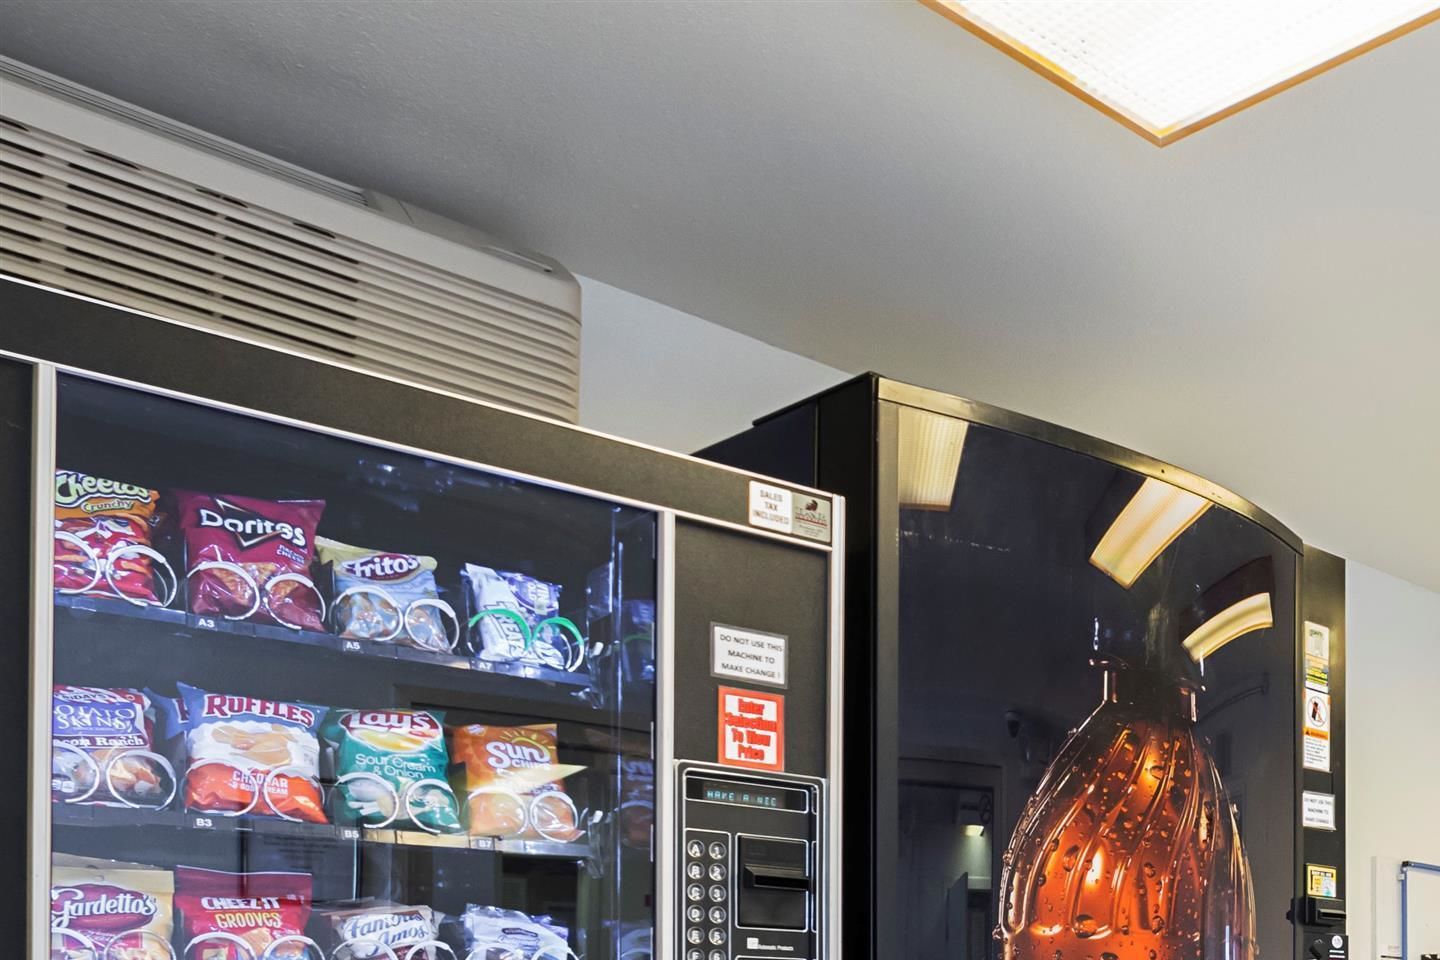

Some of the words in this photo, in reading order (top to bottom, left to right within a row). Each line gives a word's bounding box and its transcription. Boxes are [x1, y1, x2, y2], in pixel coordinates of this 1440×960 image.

[759, 488, 783, 503] SALES
[83, 498, 133, 513] Crunchy
[763, 501, 778, 513] TAX
[201, 509, 308, 547] Doritos
[343, 555, 421, 579] Fritos
[198, 618, 215, 628] A3
[346, 641, 361, 651] A5
[720, 633, 732, 643] DO
[733, 635, 749, 646] NOT
[751, 638, 765, 648] USE
[767, 641, 784, 652] THIS
[727, 649, 763, 663] MACHINE
[764, 655, 775, 665] TO
[479, 662, 493, 671] A7
[721, 662, 744, 674] MAKE
[745, 665, 776, 679] CHANGE
[54, 703, 136, 721] OTATO
[205, 694, 315, 728] RUFFLES
[53, 736, 93, 748] acon
[95, 735, 145, 747] Ranch
[355, 753, 389, 767] Sour
[391, 757, 437, 773] Cream
[486, 741, 551, 770] Sun
[374, 767, 382, 776] &
[383, 766, 424, 779] Onion
[196, 817, 212, 828] B3
[344, 830, 359, 839] B5
[52, 889, 157, 927] Gardetto's
